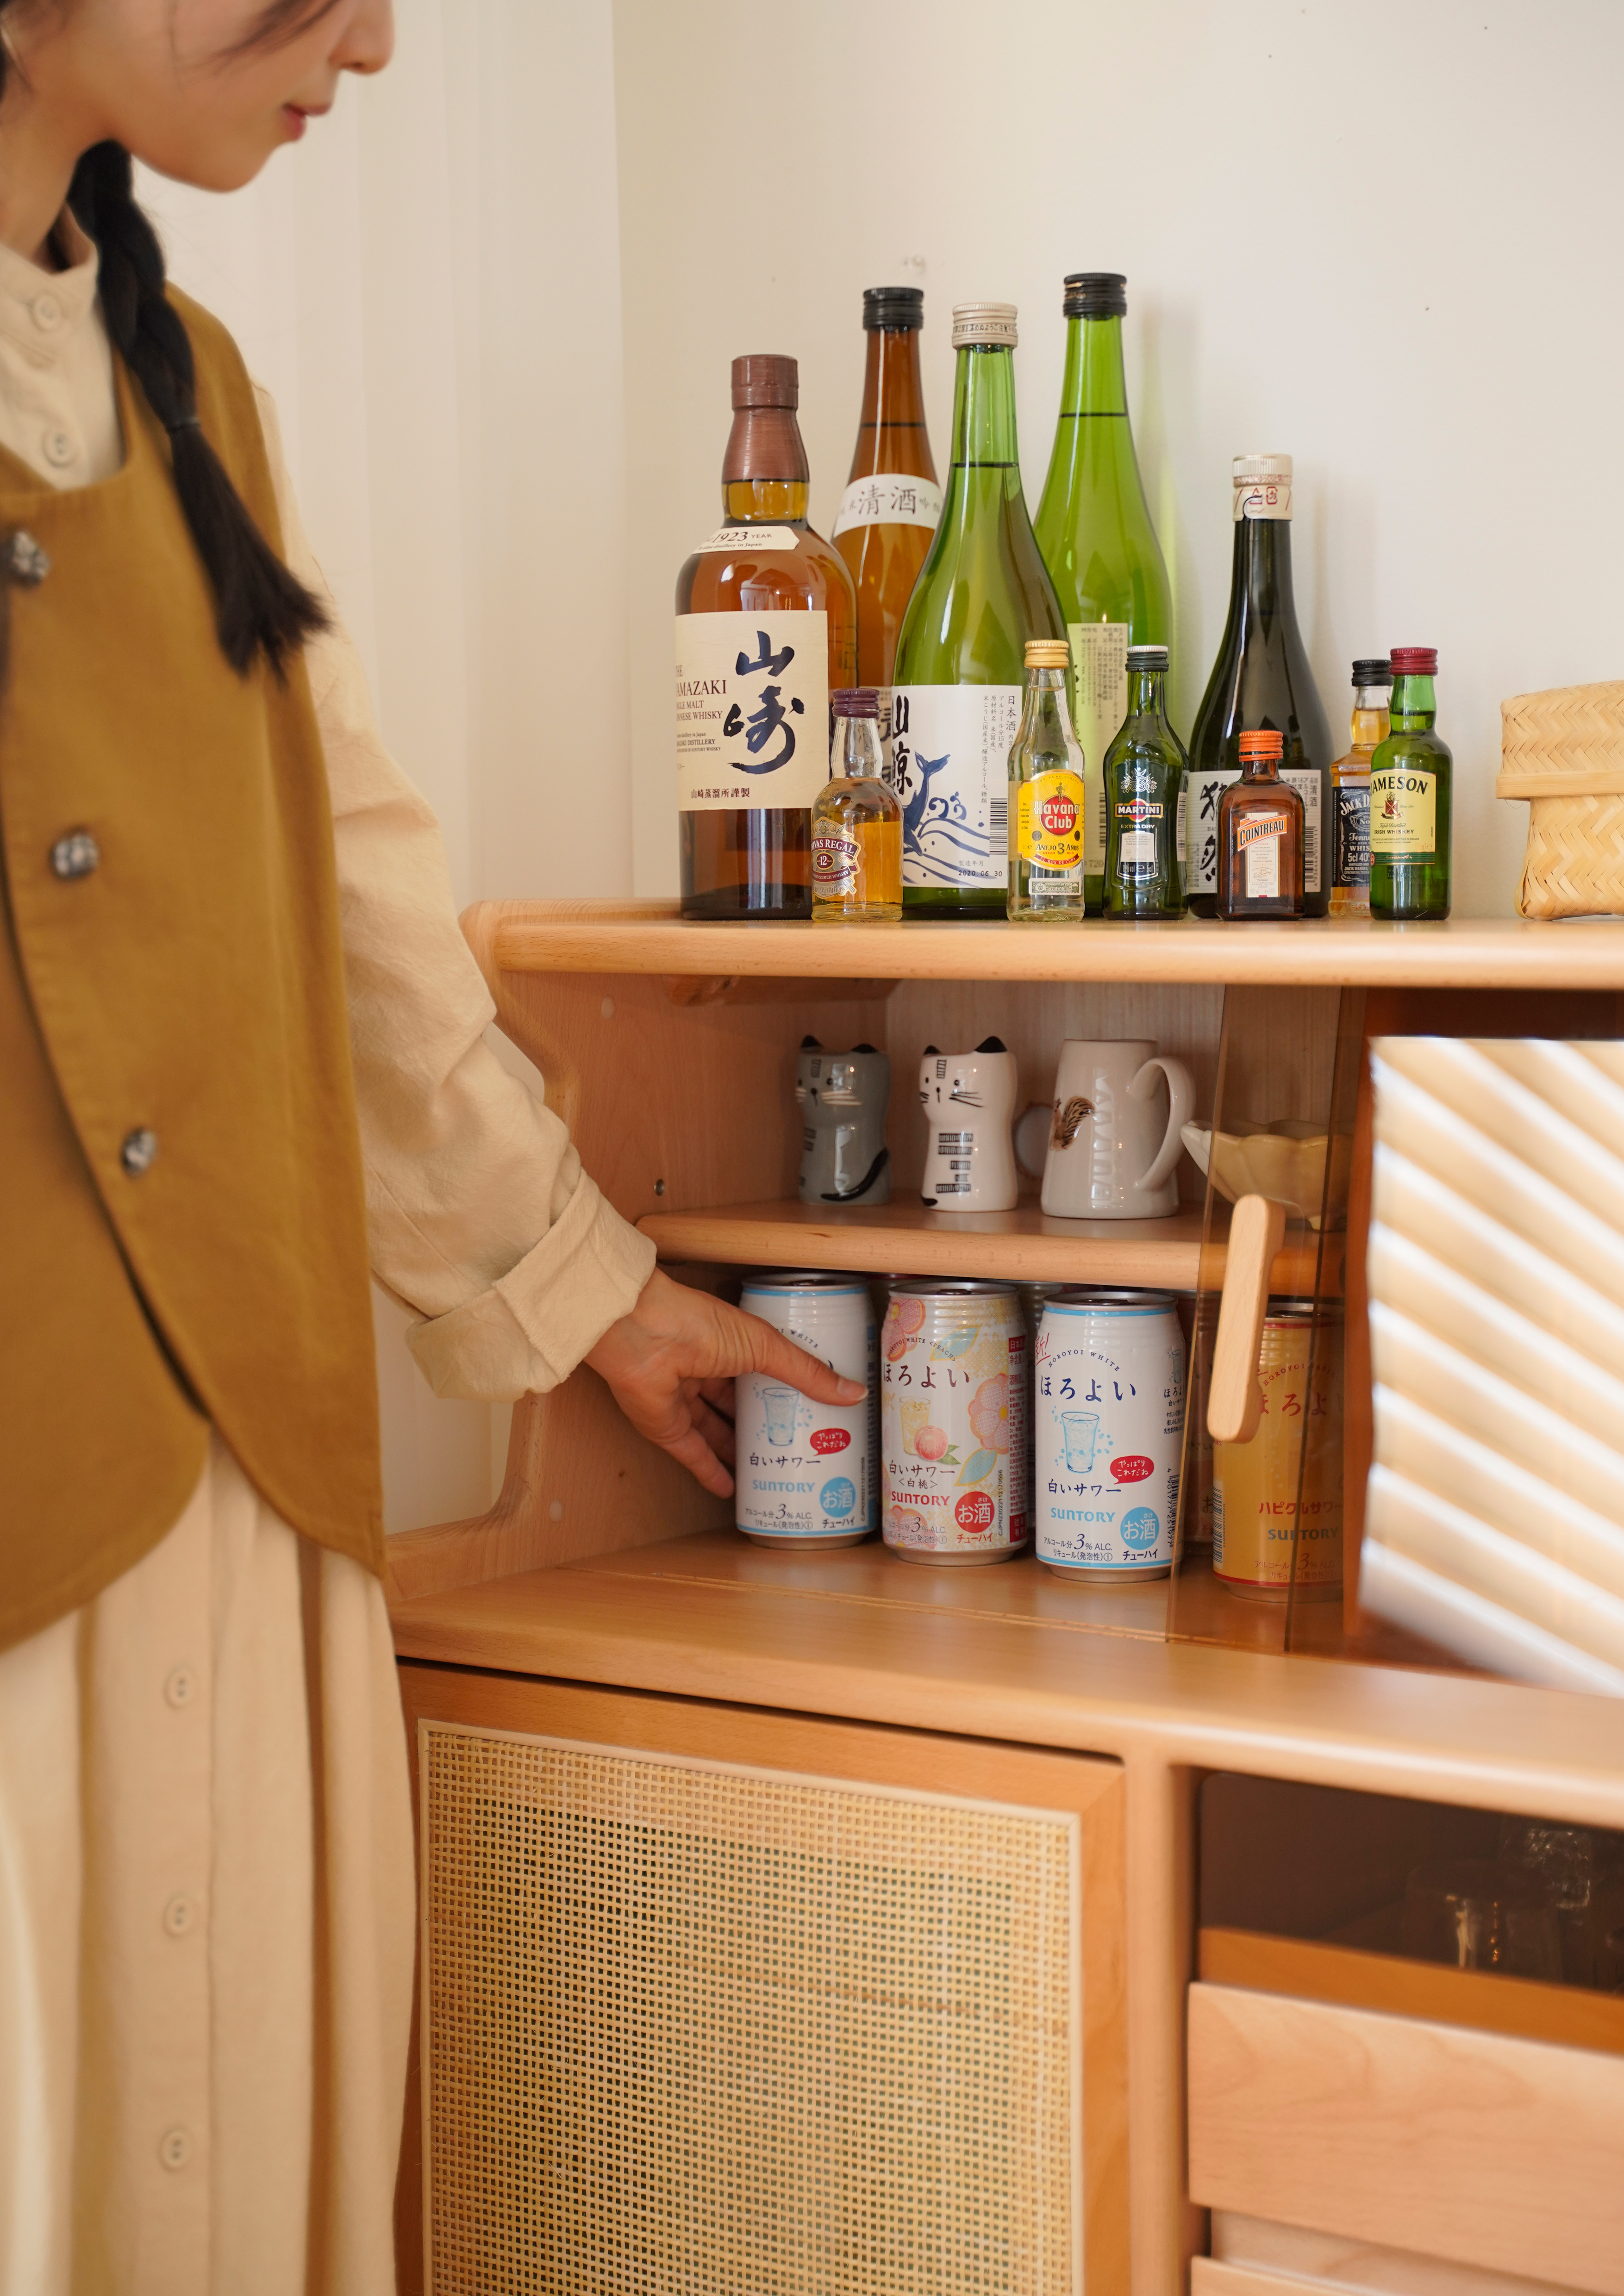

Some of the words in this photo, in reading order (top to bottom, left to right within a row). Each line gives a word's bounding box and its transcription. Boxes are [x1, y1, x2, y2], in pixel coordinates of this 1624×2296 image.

[858, 484, 916, 515] 清酒
[712, 532, 748, 543] 1923
[676, 680, 727, 697] AMAZAKI
[687, 700, 704, 709] MALT
[693, 711, 723, 720] WHISKY
[1006, 696, 1017, 731] 日本酒
[1370, 776, 1429, 796] JAMESON
[1309, 785, 1318, 807] 清酒
[1034, 800, 1080, 815] Havana
[1118, 806, 1160, 814] MARTINI
[1340, 798, 1362, 815] JACK
[1045, 815, 1072, 829] Club
[1240, 820, 1284, 846] COINTREAU
[811, 839, 824, 852] HIVAS
[825, 839, 854, 854] REGAL
[1057, 843, 1065, 854] 3
[820, 855, 827, 865] 12
[1348, 852, 1358, 862] 5cl
[832, 870, 849, 878] WHISKY
[790, 1330, 818, 1349] WHITE
[1049, 1350, 1084, 1368] HOROYOI
[1090, 1351, 1120, 1371] WHITE
[883, 1363, 969, 1389] ほろよい
[1263, 1363, 1305, 1387] HOROYOI
[1041, 1375, 1136, 1402] ほろよい
[817, 1441, 846, 1449] これだね
[750, 1452, 821, 1468] 白いサワー
[1118, 1460, 1145, 1468] やっぱり
[889, 1460, 956, 1478] 白いサワー
[1117, 1468, 1149, 1477] これだね
[752, 1480, 815, 1493] SUNTORY
[1048, 1478, 1122, 1497] 白いサワー
[823, 1487, 853, 1509] お酒
[892, 1491, 950, 1506] SUNTORY
[958, 1503, 991, 1524] お酒
[1051, 1507, 1116, 1523] SUNTORY
[823, 1517, 855, 1528] チューハイ
[1124, 1518, 1156, 1540] お酒
[956, 1532, 993, 1544] チューハイ
[1122, 1549, 1158, 1561] チューハイ
